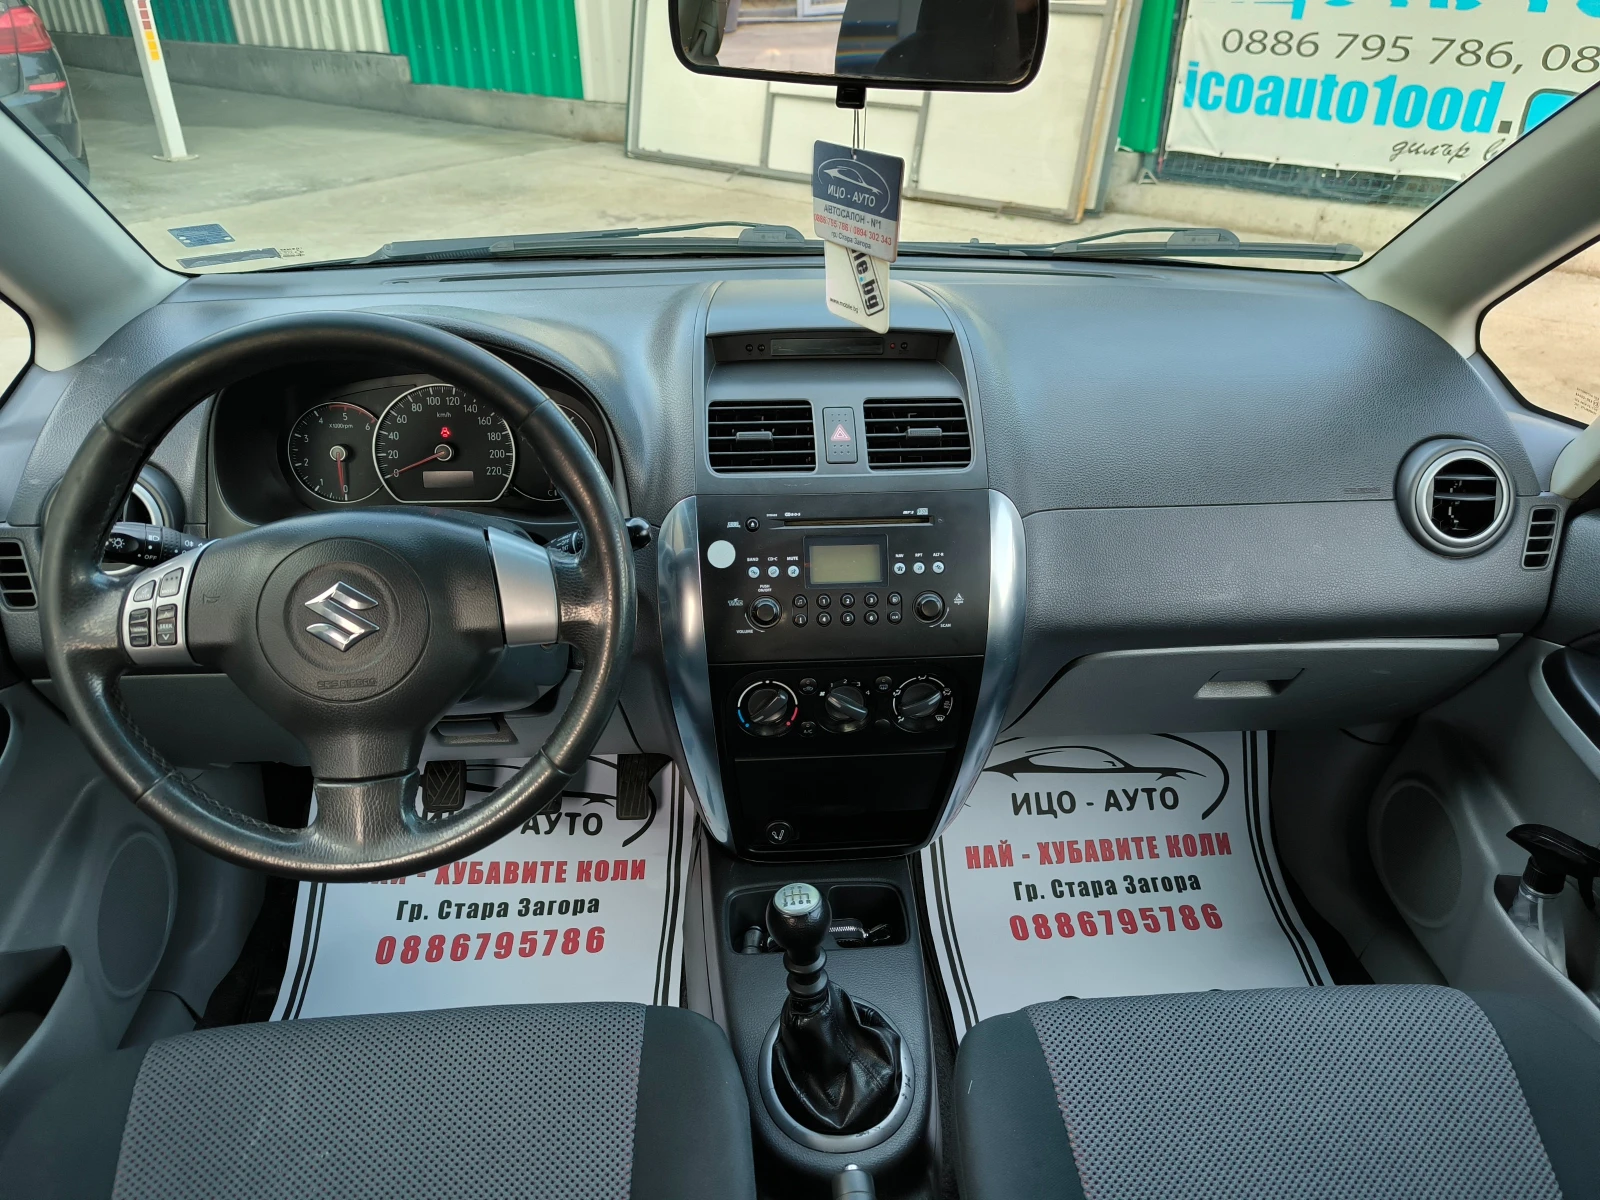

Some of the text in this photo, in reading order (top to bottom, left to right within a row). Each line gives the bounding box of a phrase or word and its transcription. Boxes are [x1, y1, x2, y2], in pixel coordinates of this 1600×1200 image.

[1221, 28, 1320, 58] 0886
[1334, 32, 1413, 63] 795
[1428, 36, 1525, 75] 786,
[1389, 140, 1470, 163] дилър
[827, 184, 846, 199] ИЦО
[852, 191, 876, 207] АУТО
[823, 204, 865, 224] АВТОСАЛОН
[868, 231, 880, 242] 302
[881, 235, 892, 246] 343
[854, 238, 872, 250] Загора
[426, 396, 441, 406] 100
[445, 396, 460, 406] 120
[411, 403, 423, 412] 80
[463, 404, 478, 413] 140
[318, 416, 324, 425] 4
[342, 412, 348, 421] 5
[396, 415, 408, 424] 60
[477, 417, 492, 426] 160
[365, 422, 371, 431] 6
[303, 434, 309, 443] 3
[388, 431, 400, 440] 40
[487, 432, 502, 442] 180
[388, 449, 399, 459] 20
[489, 449, 506, 459] 200
[303, 458, 309, 467] 2
[393, 468, 399, 478] 0
[486, 466, 502, 476] 220
[319, 478, 325, 487] 1
[342, 484, 349, 494] 0
[1011, 790, 1077, 819] ИЦО
[1104, 786, 1180, 812] АУТО
[965, 840, 1014, 869] НАЙ
[1036, 836, 1160, 866] ХУБАВИТЕ
[1165, 832, 1232, 858] КОЛИ
[434, 861, 568, 885] ХУБАВИТЕ
[575, 859, 646, 883] КОЛИ
[1013, 874, 1202, 902] Гр. Стара Загора
[396, 897, 600, 923] Гр. Стара Загора
[1009, 903, 1224, 941] 0886795786
[375, 926, 607, 965] 0886795786
